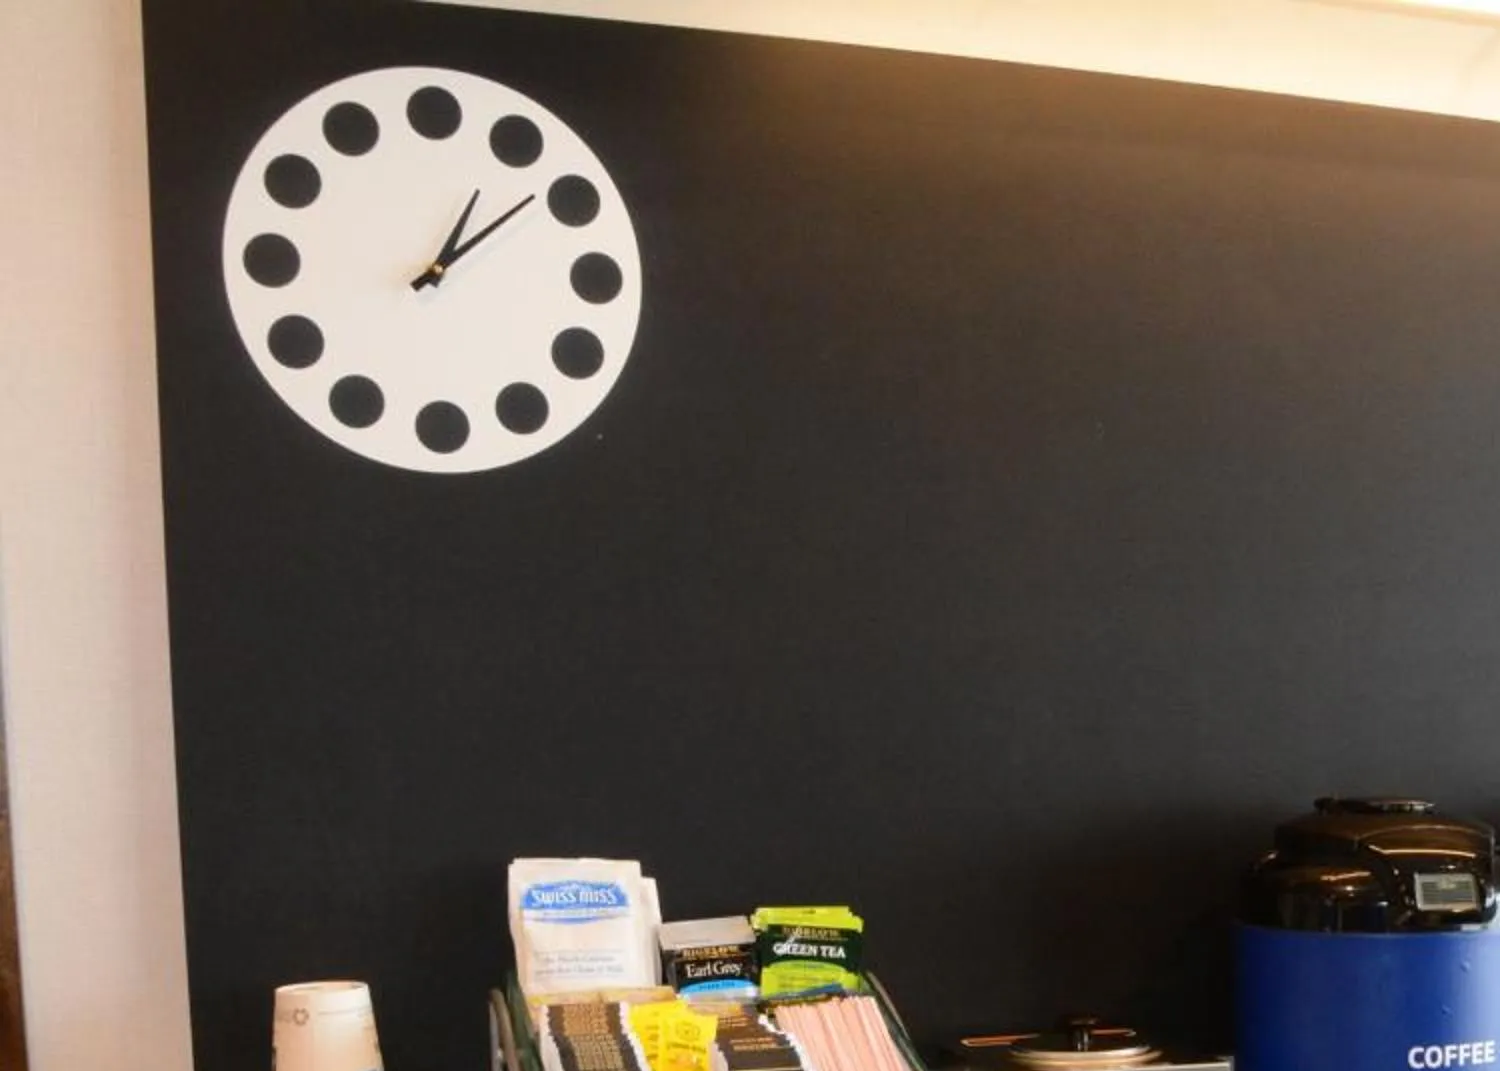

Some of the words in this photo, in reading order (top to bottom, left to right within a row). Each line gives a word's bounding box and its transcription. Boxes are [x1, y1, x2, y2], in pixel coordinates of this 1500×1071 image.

[773, 942, 818, 957] GREEN
[820, 945, 847, 959] TEA
[686, 963, 713, 978] Earl
[713, 960, 744, 977] Grey
[1407, 1040, 1497, 1070] COFFEE
